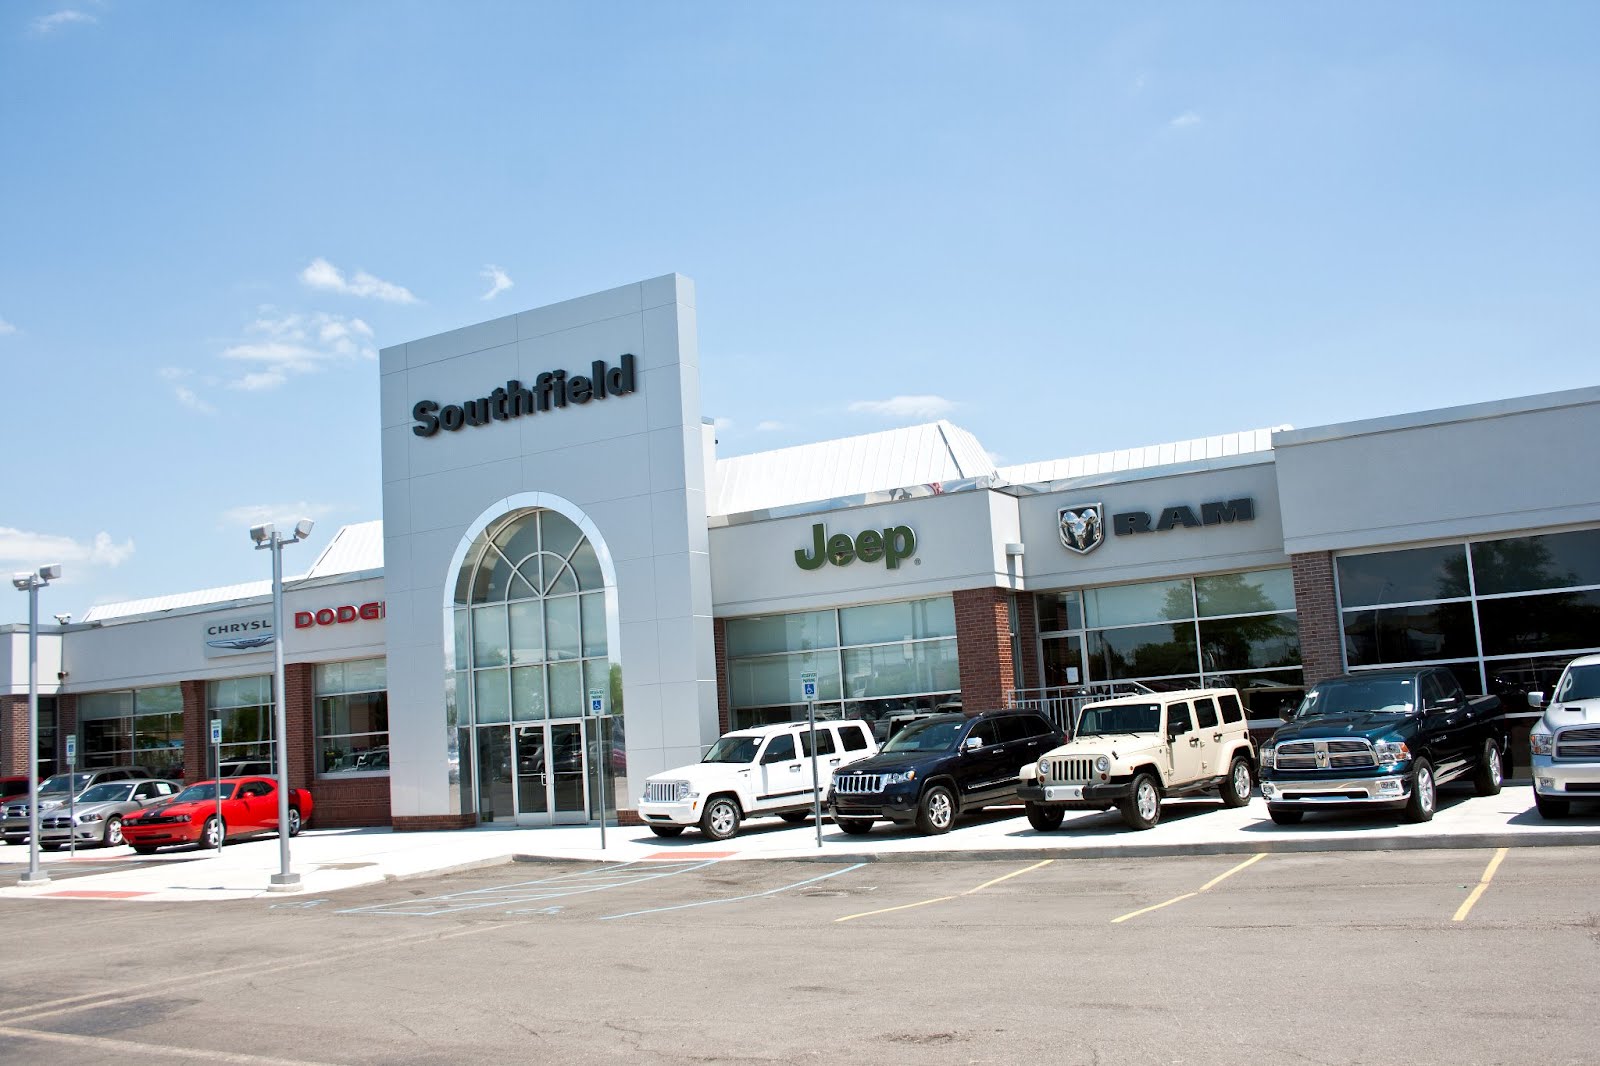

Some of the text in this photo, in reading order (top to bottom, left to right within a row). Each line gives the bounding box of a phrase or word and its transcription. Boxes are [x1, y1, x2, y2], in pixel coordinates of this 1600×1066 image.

[413, 353, 635, 437] Southfield
[1113, 498, 1254, 536] RAM
[795, 522, 916, 570] Jeep
[207, 619, 272, 636] CHRYSL
[294, 601, 386, 629] DODG
